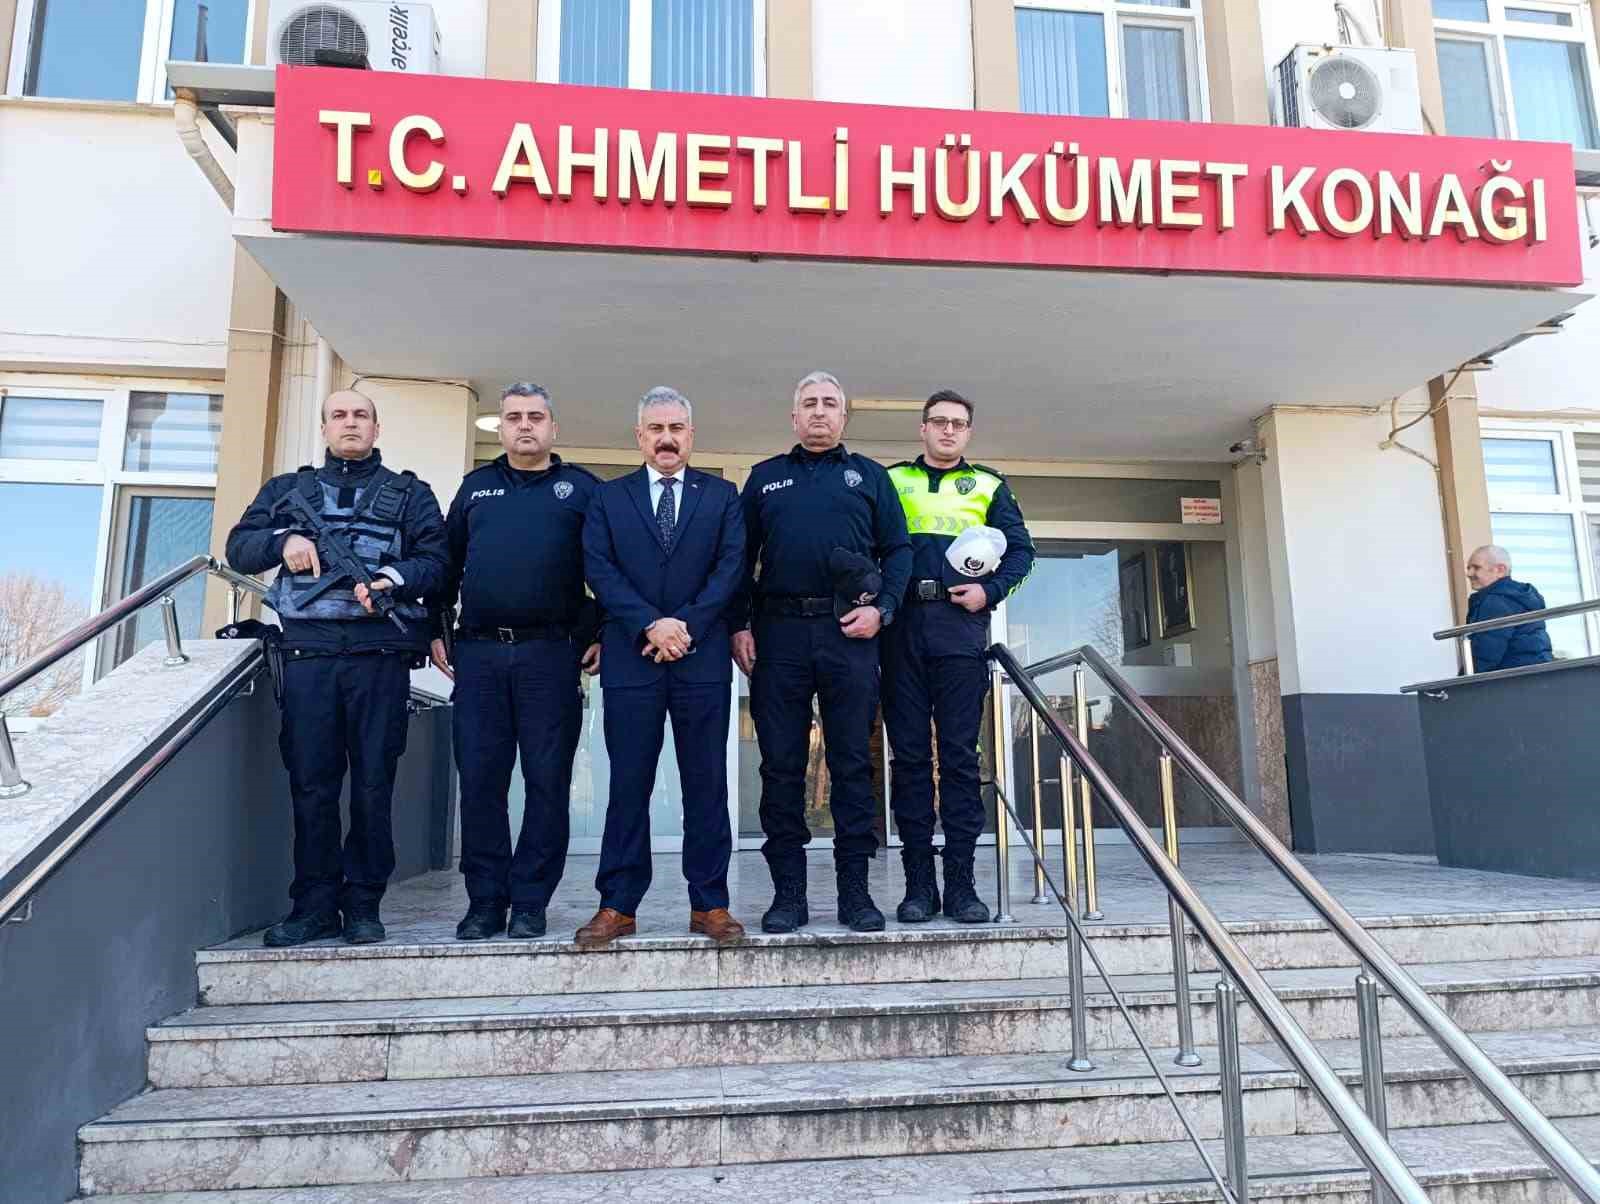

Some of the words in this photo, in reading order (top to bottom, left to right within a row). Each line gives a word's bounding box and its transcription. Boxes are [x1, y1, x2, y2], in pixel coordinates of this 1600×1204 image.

[390, 5, 412, 71] arçelik
[318, 110, 468, 194] T.C.
[491, 123, 849, 213] AHMETLİ
[879, 134, 1248, 231] HÜKÜMET
[1269, 160, 1547, 243] KONAĞI
